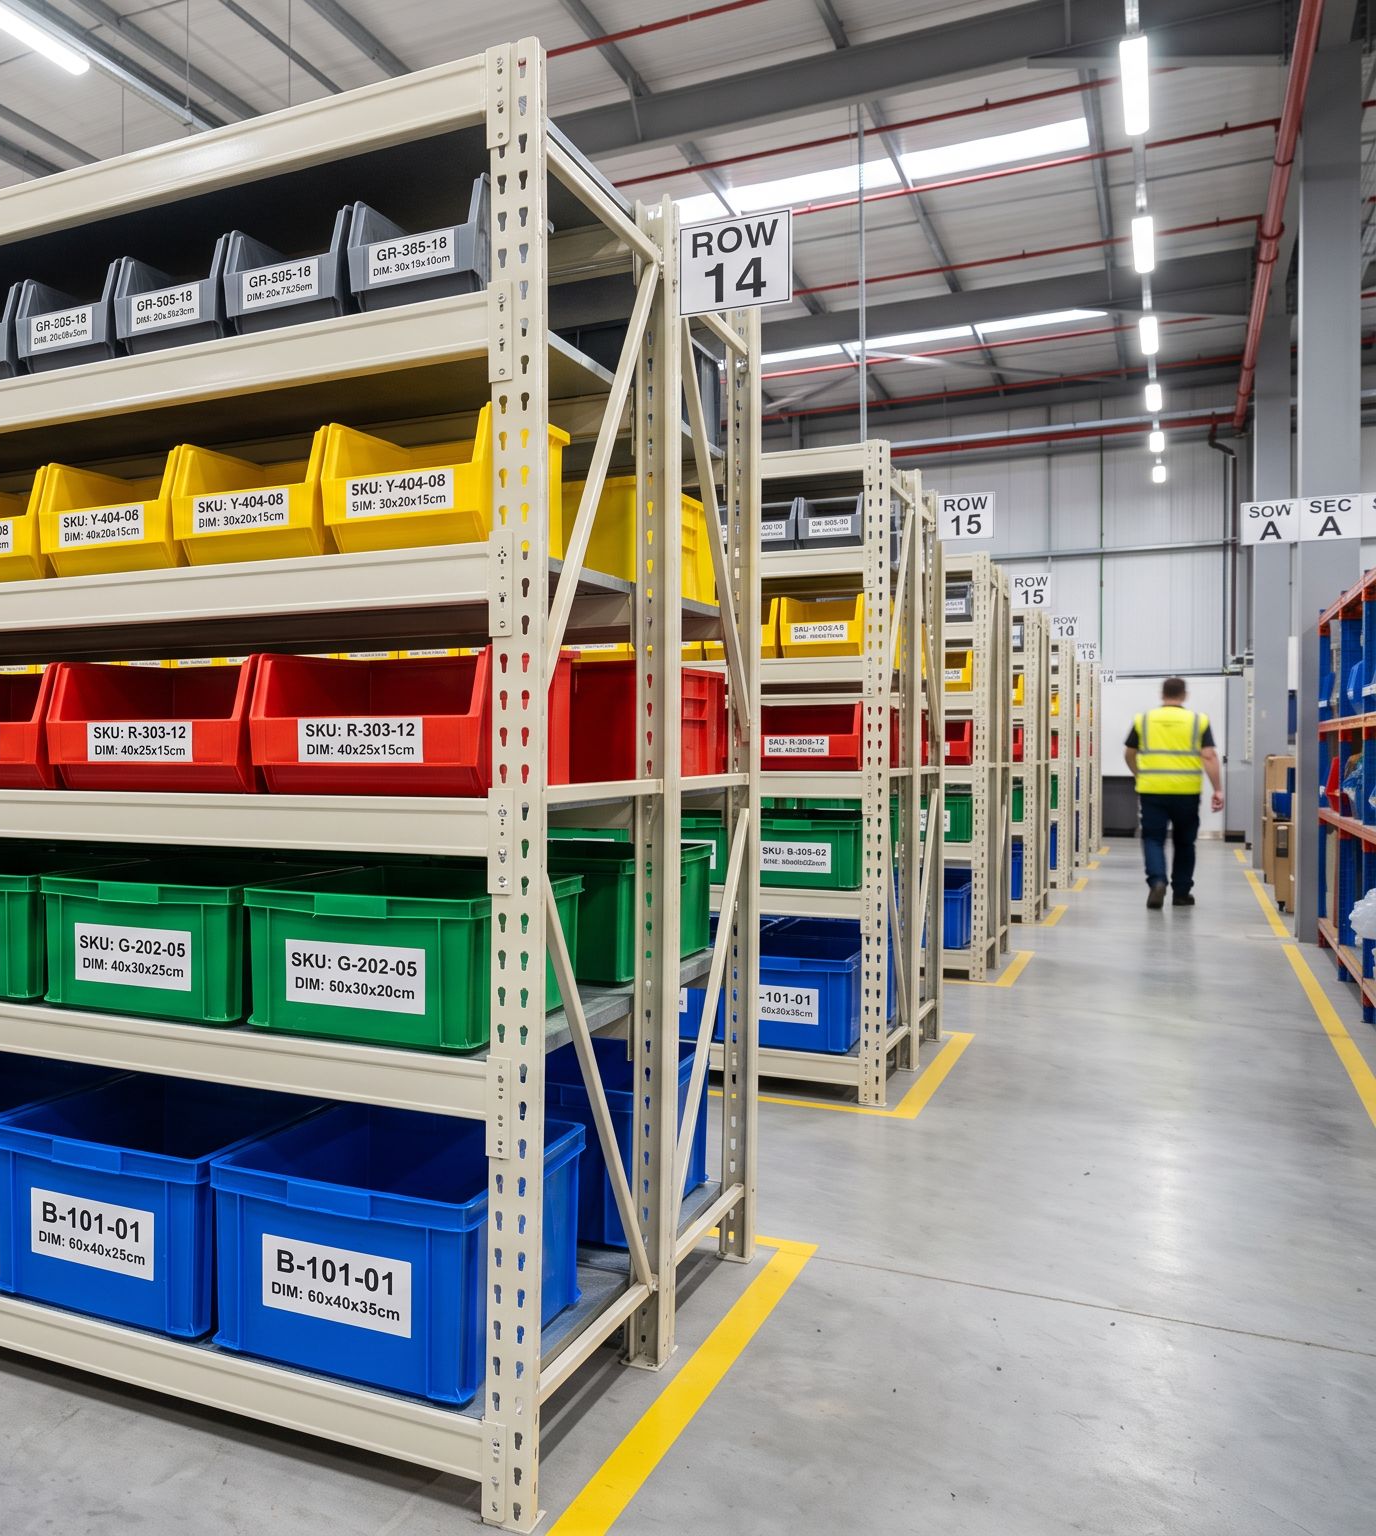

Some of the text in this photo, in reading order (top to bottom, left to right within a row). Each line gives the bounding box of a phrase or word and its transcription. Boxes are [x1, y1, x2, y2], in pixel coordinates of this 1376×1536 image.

[692, 219, 778, 258] ROW
[373, 266, 393, 276] DIM:
[705, 257, 766, 303] 14
[137, 290, 192, 312] GR-505-18
[246, 292, 264, 302] DIM:
[352, 474, 446, 496] SKU: Y-404-08
[198, 493, 284, 513] SKU: Y-404-08
[379, 494, 446, 509] 30x20x15cm
[944, 496, 987, 512] ROW
[1310, 498, 1352, 514] SEC
[224, 512, 284, 526] 30x20x15cm
[1249, 504, 1291, 518] SOW
[64, 516, 88, 528] SKU:
[951, 514, 982, 536] 15
[1260, 520, 1282, 540] A
[1318, 516, 1342, 536] A
[1014, 577, 1048, 588] ROW
[1021, 590, 1044, 605] 15
[94, 726, 186, 739] SKU: R-303-12
[306, 723, 414, 737] SKU: R-303-12
[94, 745, 185, 756] DIM: 40x25x15cm
[306, 744, 414, 755] DIM: 40x25x15cm
[80, 935, 186, 958] SKU: G-202-05
[82, 958, 184, 978] DIM: 40x30x25cm
[291, 952, 417, 977] SKU: G-202-05
[295, 977, 324, 990] DIM:
[759, 992, 810, 1006] -101-01
[42, 1201, 139, 1242] B-101-01
[39, 1230, 145, 1266] DIM: 60x40x25cm
[277, 1249, 393, 1296] B-101-01
[272, 1282, 400, 1321] DIM: 60x40x35cm
